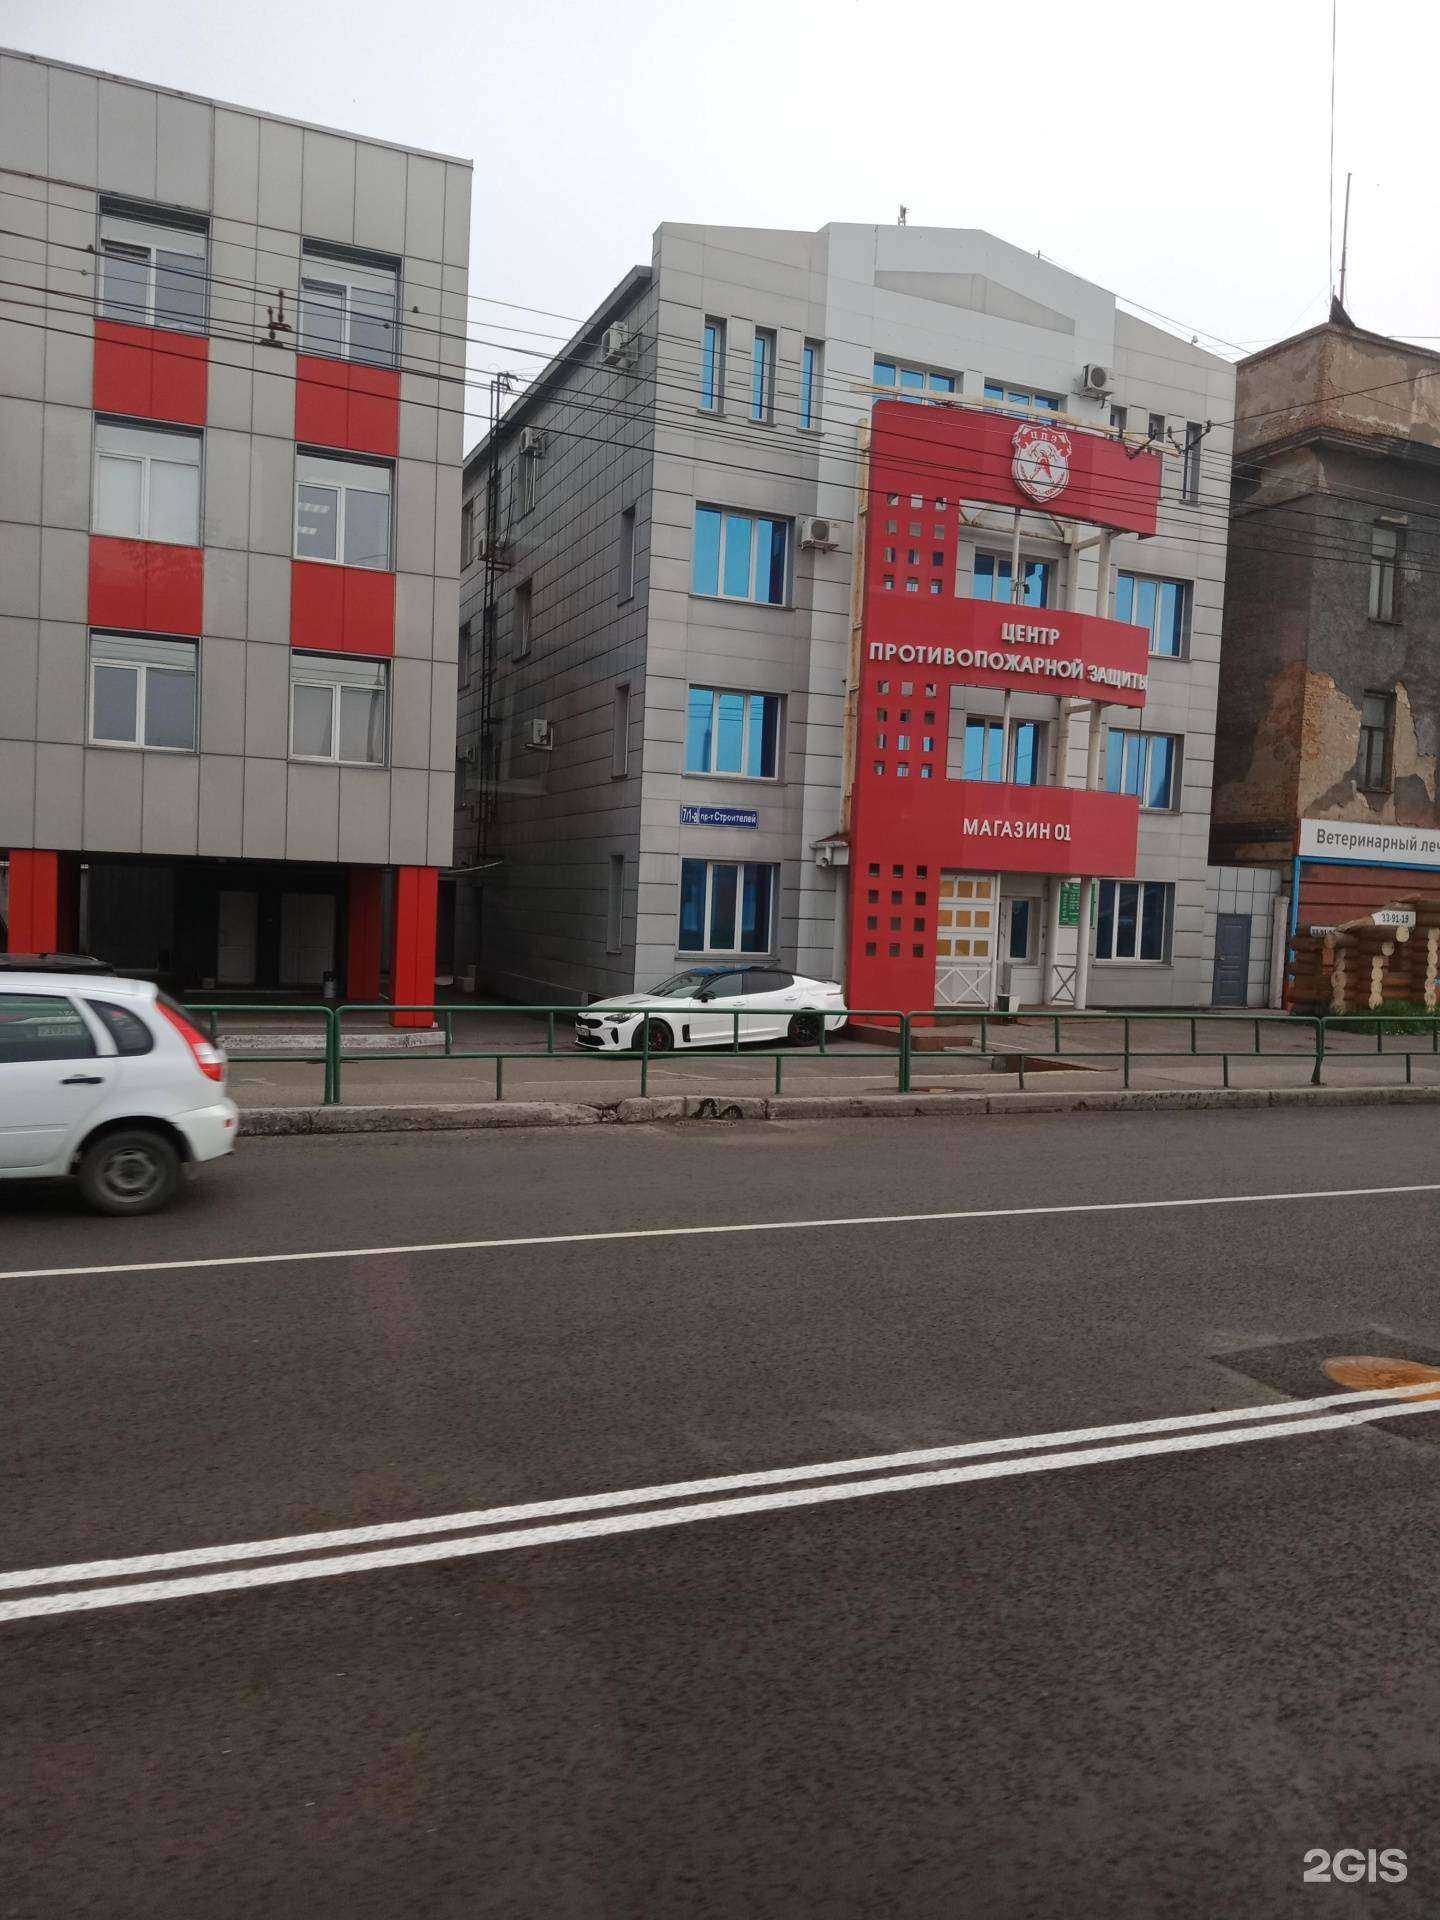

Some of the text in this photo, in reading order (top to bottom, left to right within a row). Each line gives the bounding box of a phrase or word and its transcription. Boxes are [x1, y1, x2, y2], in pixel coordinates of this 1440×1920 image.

[1001, 622, 1060, 646] ЦЕНТР
[869, 642, 1084, 680] ПРОТИВОПОЖАРНОЙ
[700, 813, 714, 822] пр-т
[714, 811, 756, 824] Строителей
[963, 818, 1071, 841] МАГАЗИН 01
[1316, 828, 1417, 852] Ветеринарный
